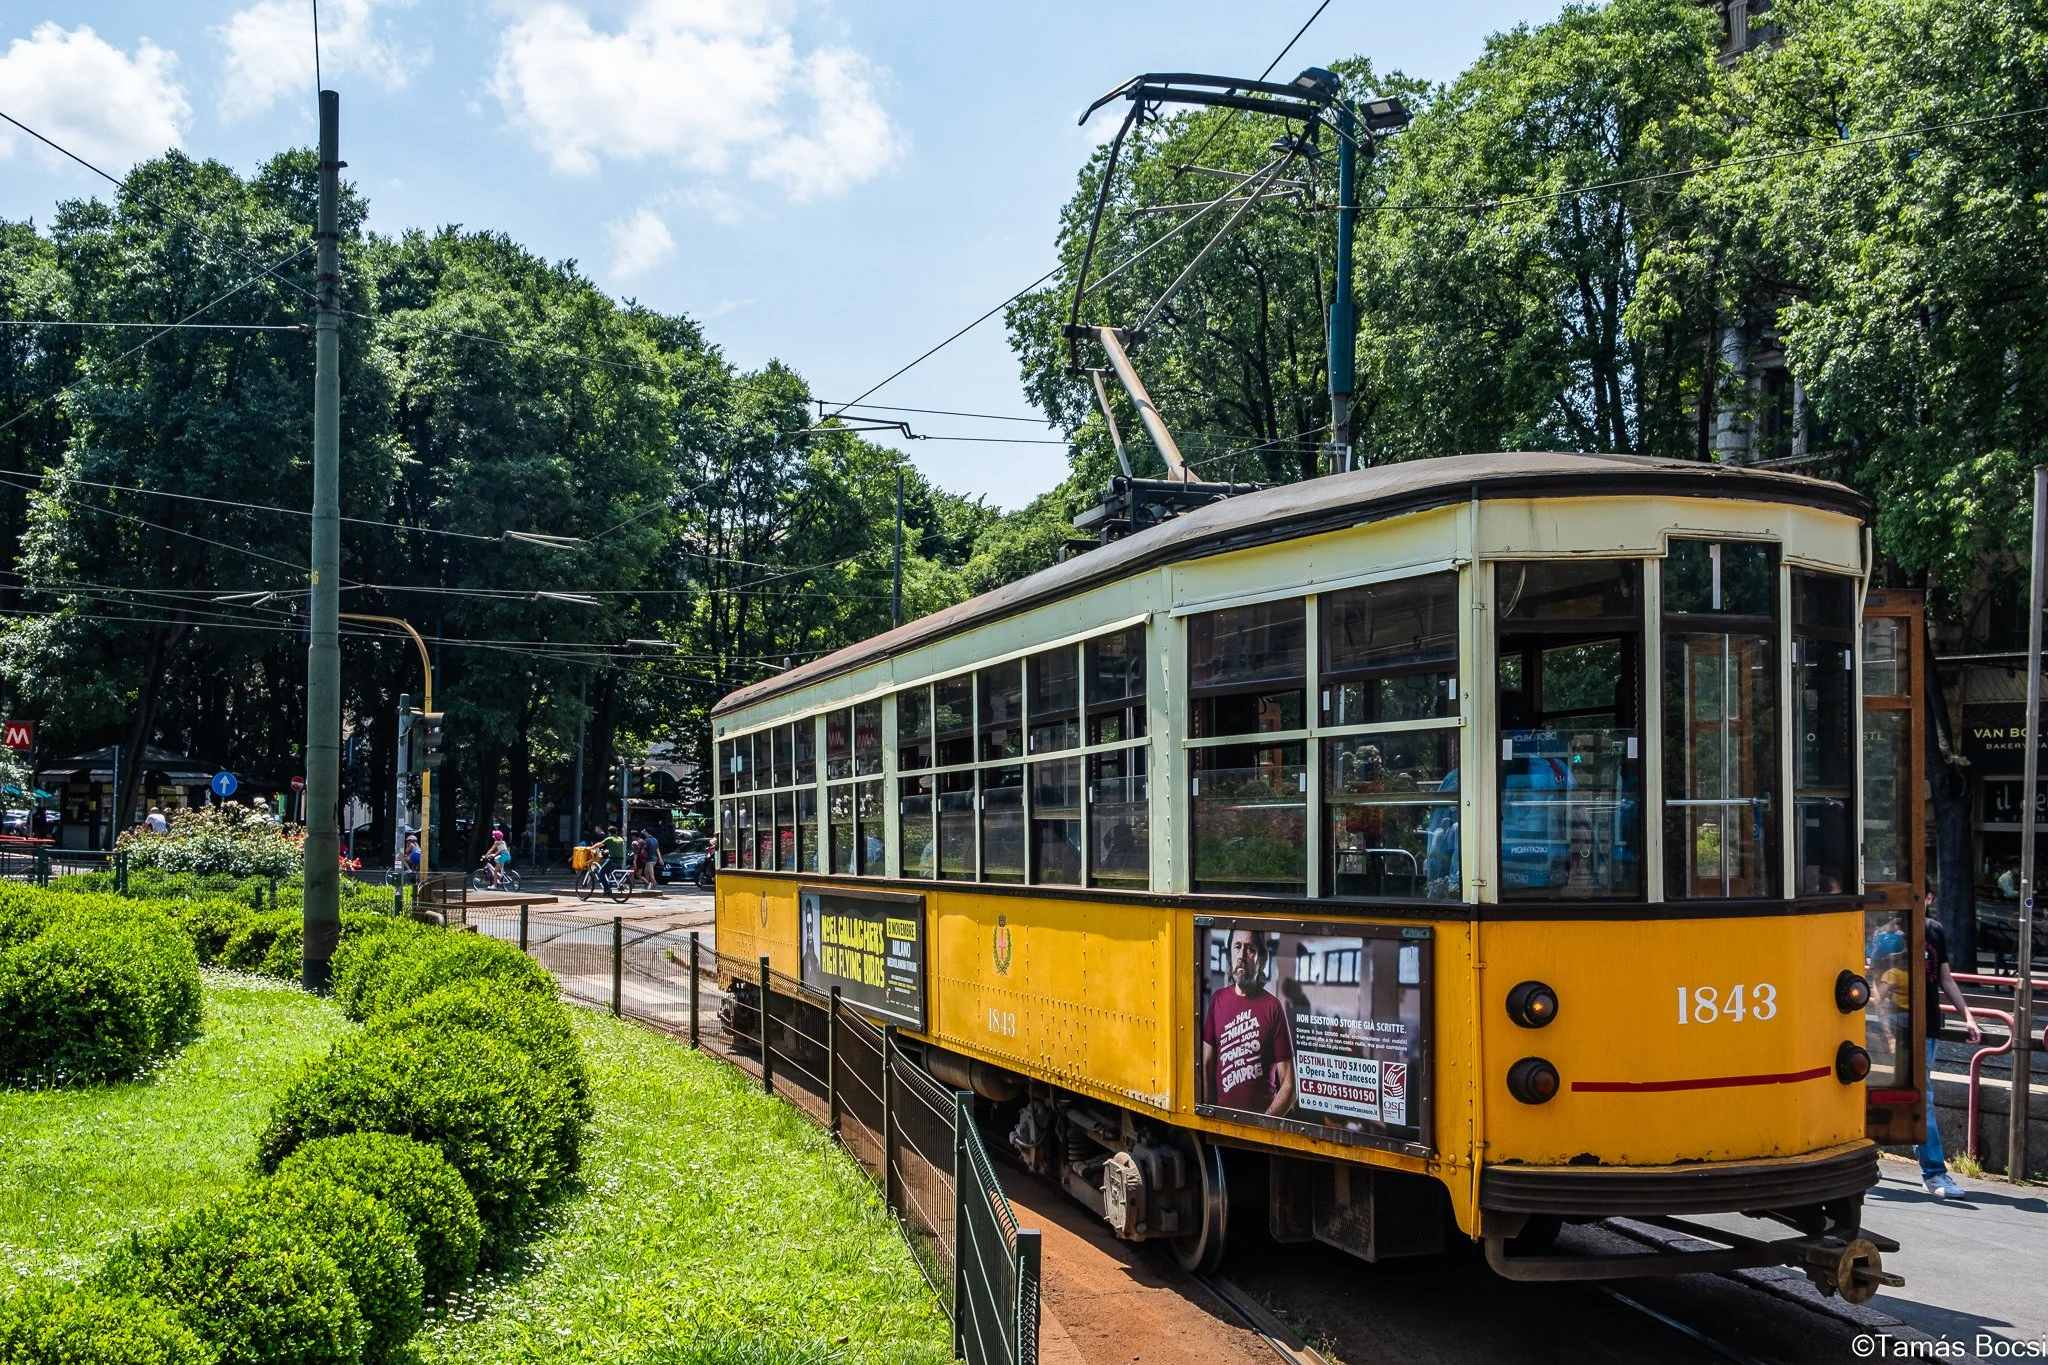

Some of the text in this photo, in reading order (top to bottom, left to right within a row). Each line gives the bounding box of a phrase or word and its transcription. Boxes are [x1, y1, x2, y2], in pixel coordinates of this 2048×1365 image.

[1710, 544, 1720, 609] 1
[6, 728, 29, 744] M
[1974, 729, 2004, 738] VAN
[1997, 784, 2011, 810] il
[892, 921, 914, 938] NOVEMBRE
[892, 940, 911, 958] MILANO
[822, 945, 884, 988] HIGH FLYING BIRDS
[1677, 983, 1777, 1025] 1843
[989, 1008, 1015, 1037] 1843
[1236, 1009, 1251, 1025] HAI
[1296, 1013, 1407, 1034] NON ESISTONO STORIE GIÀ SCRITTE.
[1228, 1017, 1260, 1041] NULLA
[1220, 1040, 1260, 1066] POVERO
[1234, 1058, 1246, 1068] PER
[1299, 1055, 1377, 1074] DESTINA IL TUO 5X1000
[1305, 1066, 1325, 1077] Opera
[1328, 1069, 1339, 1079] San
[1342, 1071, 1376, 1084] Francesco
[1222, 1062, 1263, 1092] SEMPRE
[1302, 1080, 1375, 1102] C.F. 97051510150
